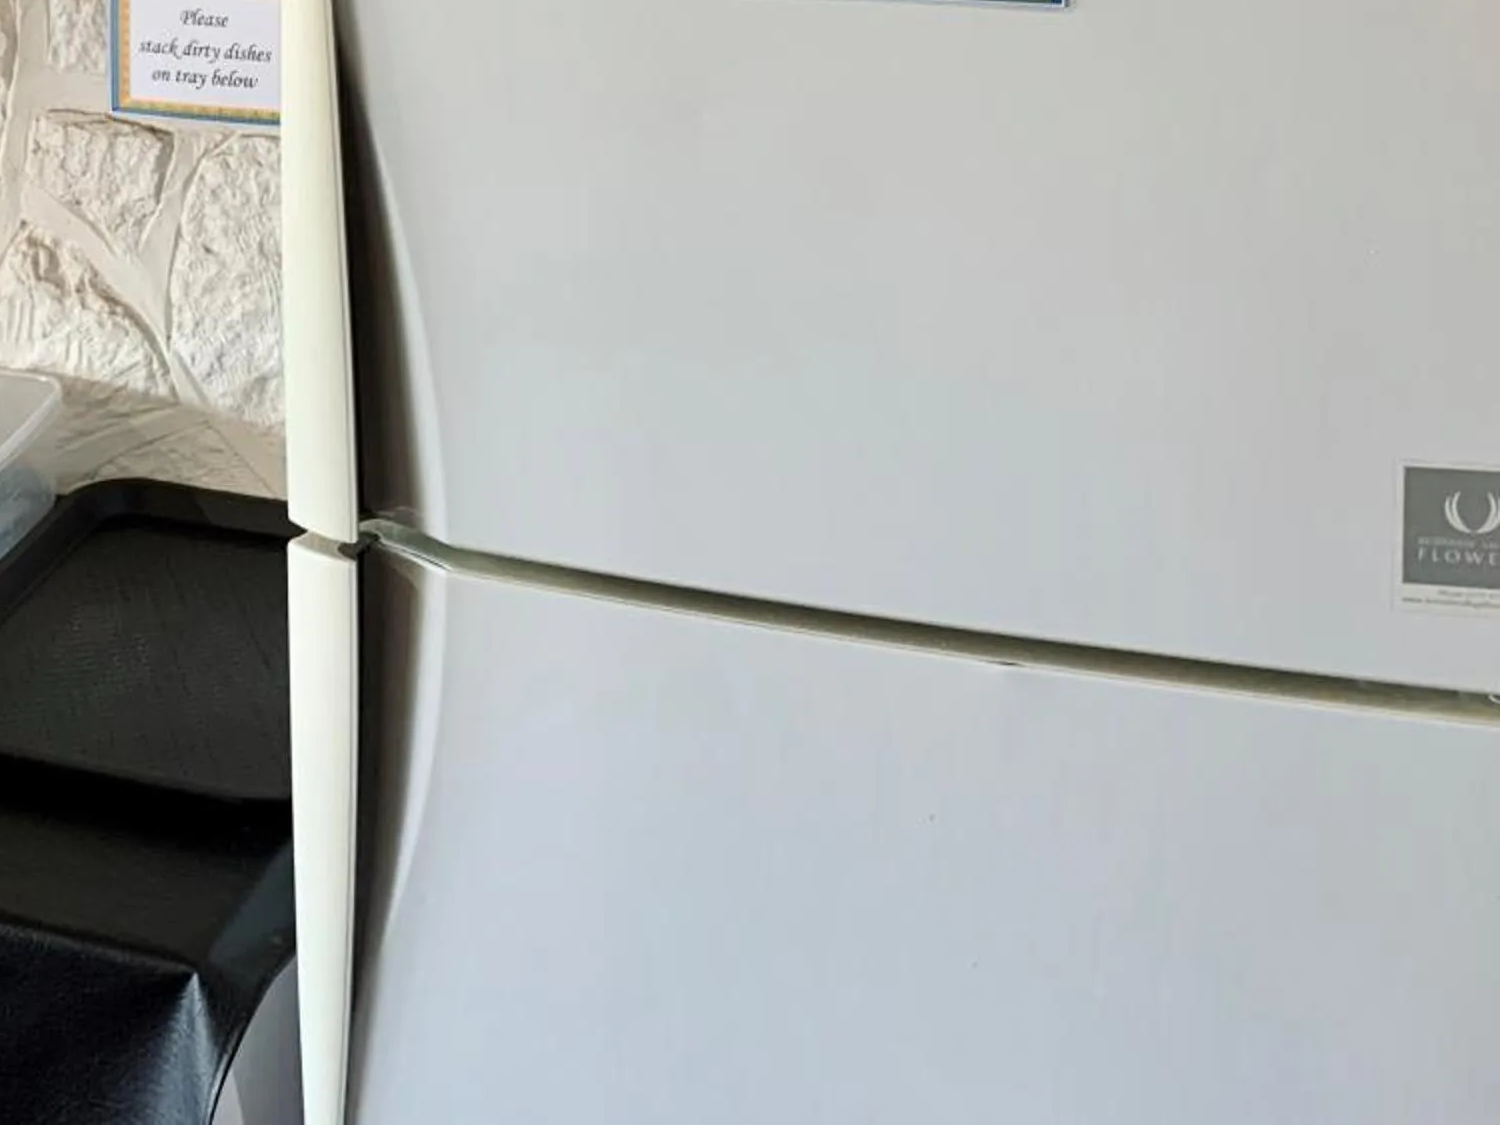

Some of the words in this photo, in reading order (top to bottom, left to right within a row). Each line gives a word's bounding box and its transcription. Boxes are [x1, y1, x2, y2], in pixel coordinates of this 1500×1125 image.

[180, 8, 229, 28] Please
[139, 37, 182, 60] stack
[183, 39, 221, 64] dirty
[223, 42, 273, 63] dishes
[151, 69, 171, 82] on
[175, 69, 207, 90] tray
[211, 67, 259, 89] below
